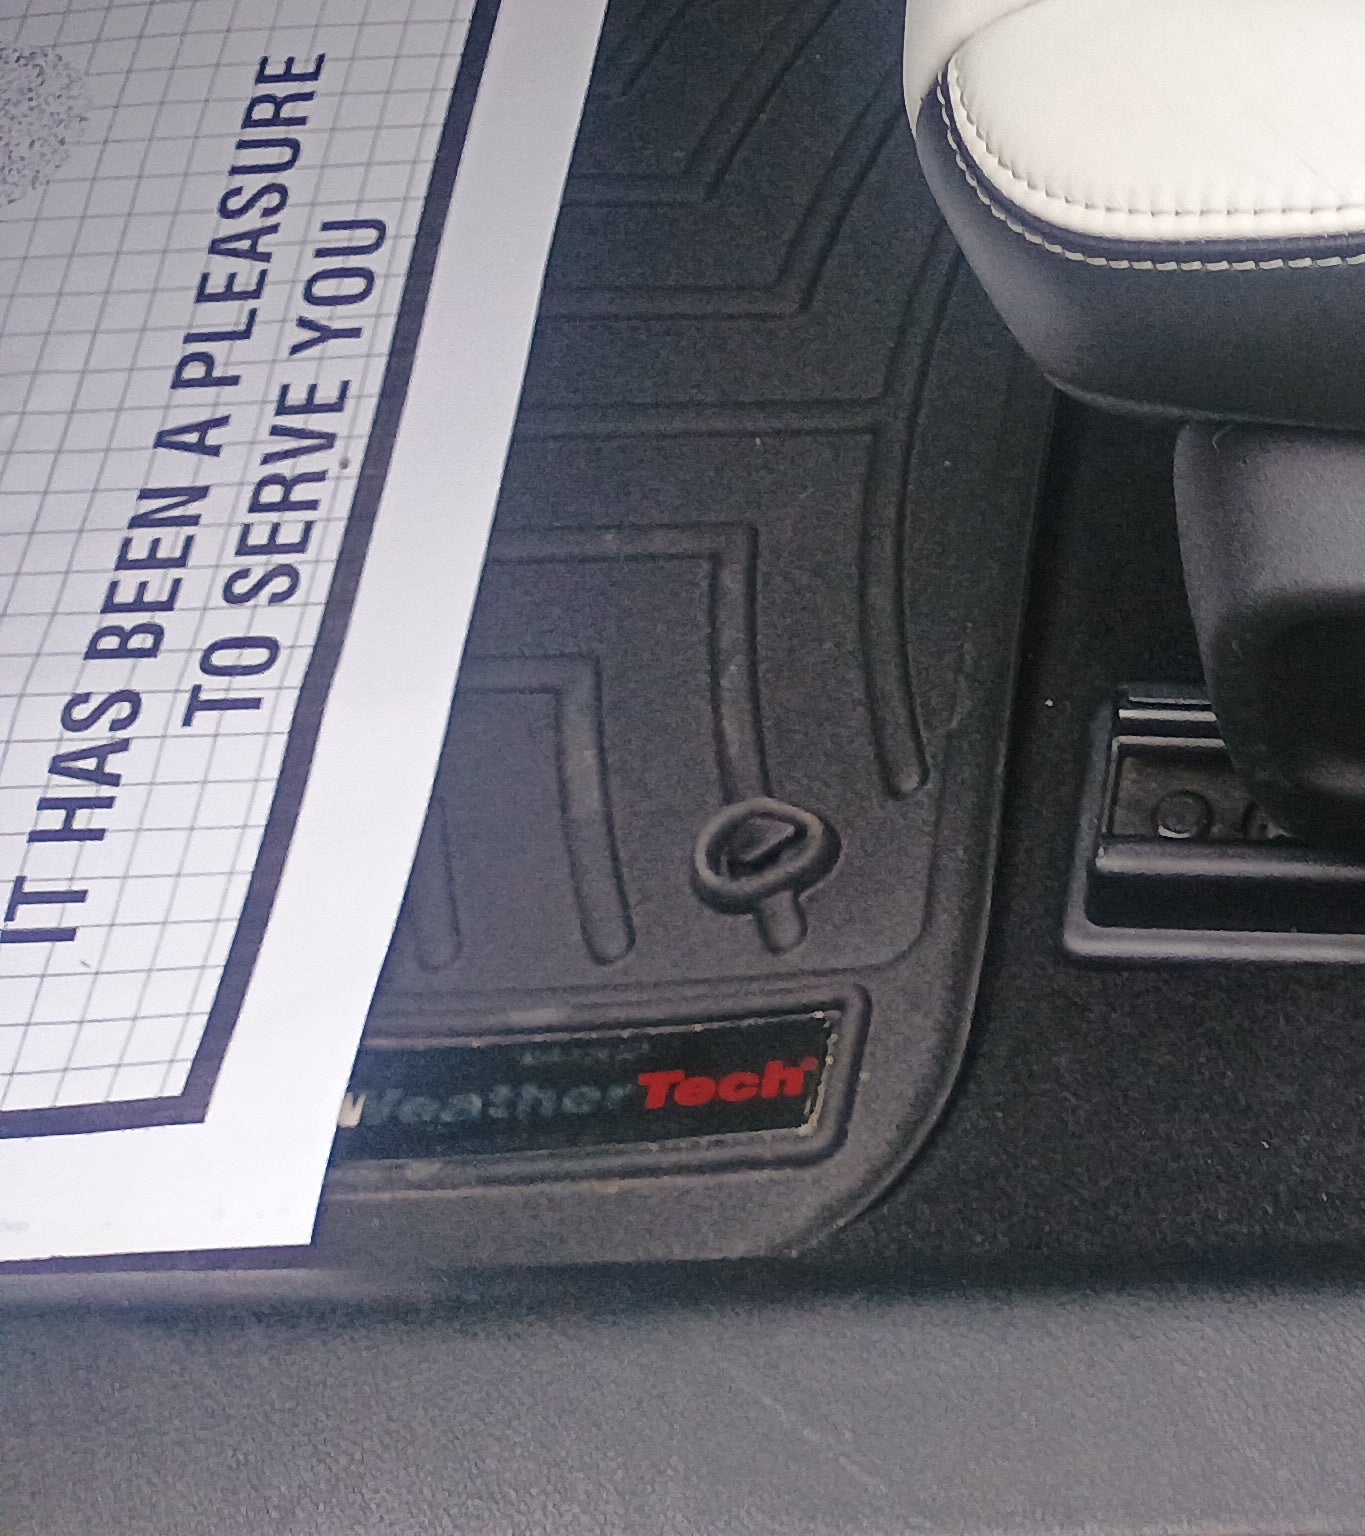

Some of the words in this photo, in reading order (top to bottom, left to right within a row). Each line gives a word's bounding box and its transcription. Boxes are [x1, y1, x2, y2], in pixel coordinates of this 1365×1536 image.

[170, 52, 327, 390] PLEASURE
[289, 218, 387, 356] YOU
[153, 414, 231, 457] A
[222, 379, 352, 606] SERVE
[83, 485, 210, 661] BEEN
[181, 635, 281, 727] TO
[26, 689, 143, 843] HAS
[0, 876, 88, 944] IT
